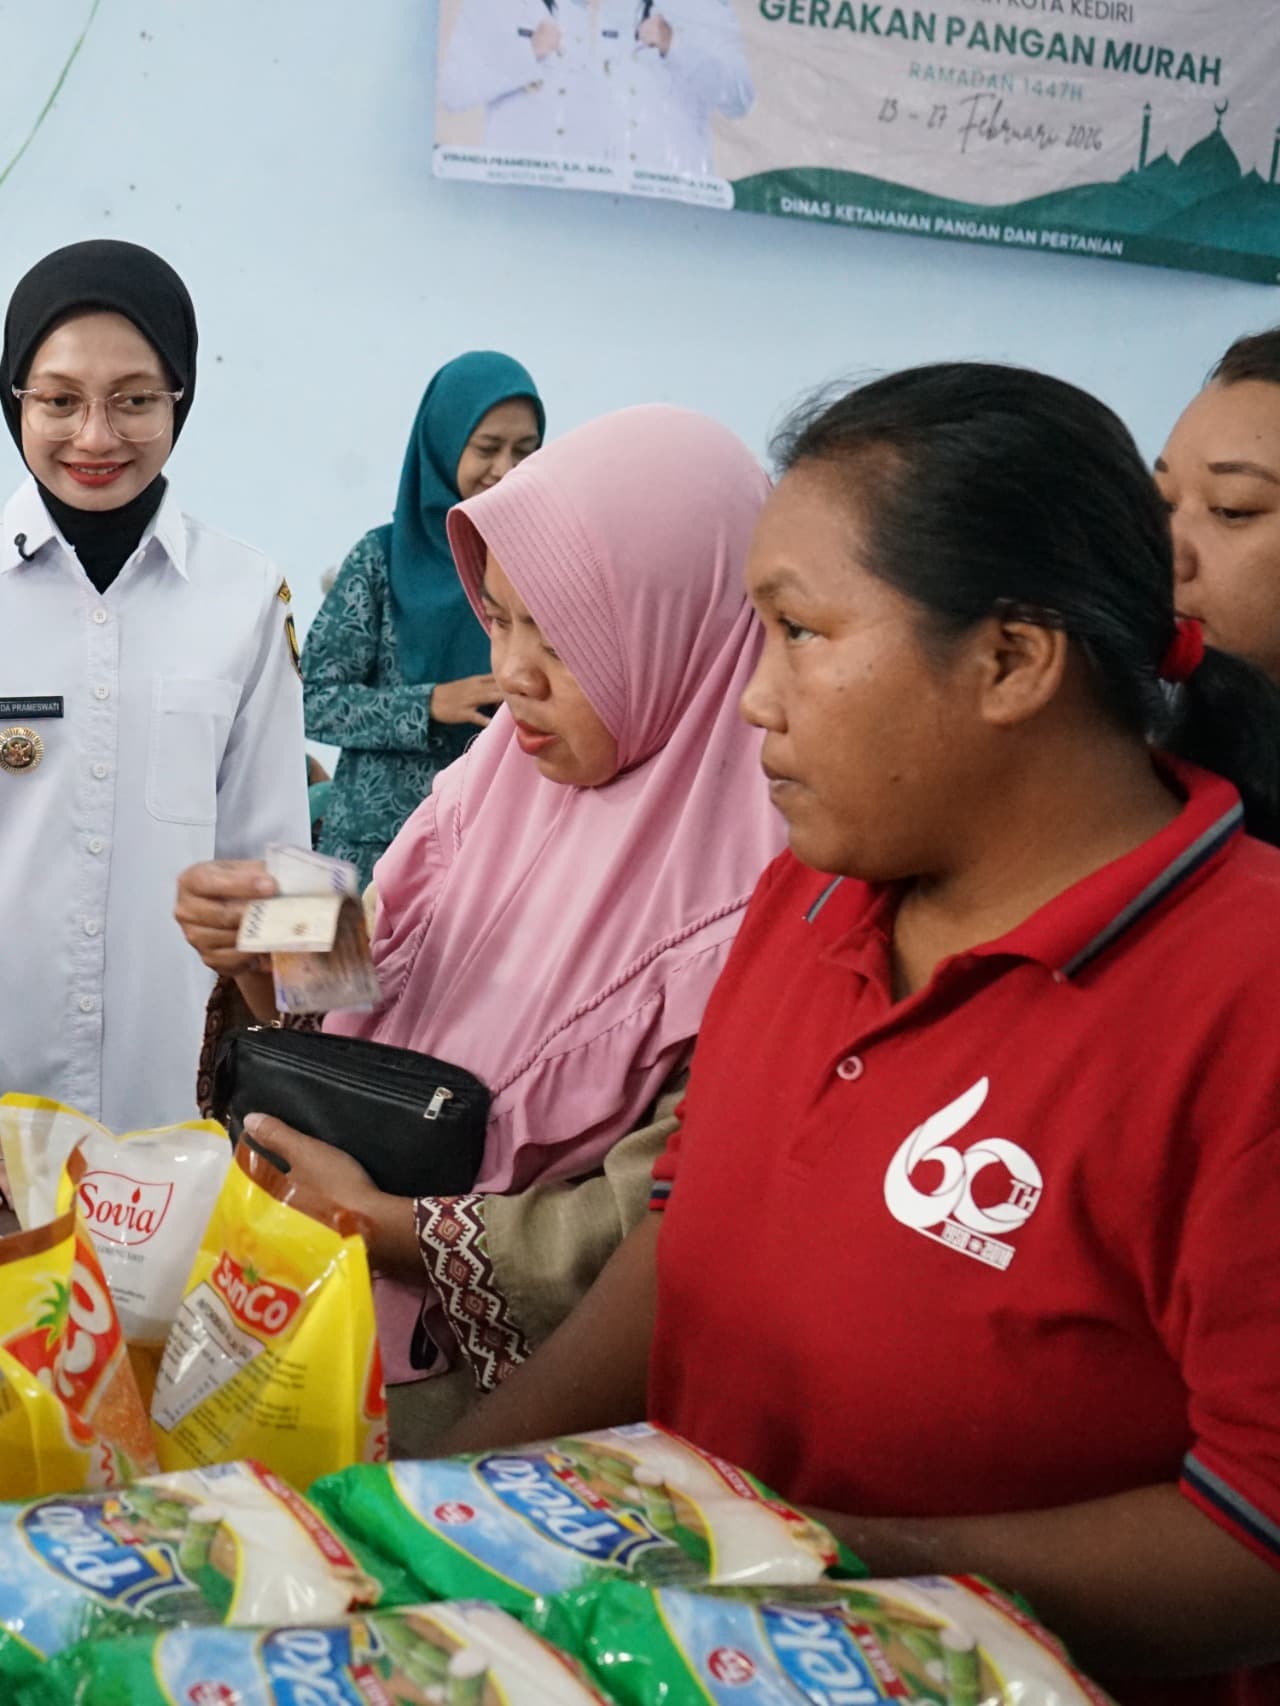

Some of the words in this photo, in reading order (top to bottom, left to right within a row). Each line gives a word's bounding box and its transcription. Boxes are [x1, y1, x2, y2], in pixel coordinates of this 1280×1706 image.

[1071, 0, 1133, 23] KEDIRI
[758, 0, 936, 43] GERAKAN
[945, 16, 1095, 66] PANGAN
[1103, 39, 1222, 86] MURAH
[907, 62, 1014, 92] RAMADAN
[1024, 76, 1084, 103] 1447H
[958, 92, 1059, 154] Februari
[1065, 123, 1103, 151] 2026
[780, 196, 832, 218] DINAS
[834, 203, 931, 232] KETAHANAN
[934, 216, 1000, 240] PANGAN
[1003, 226, 1037, 245] DAN
[1040, 230, 1124, 256] PERTANIAN
[12, 702, 60, 713] PRAMESWATI
[78, 1182, 156, 1234] Sovia
